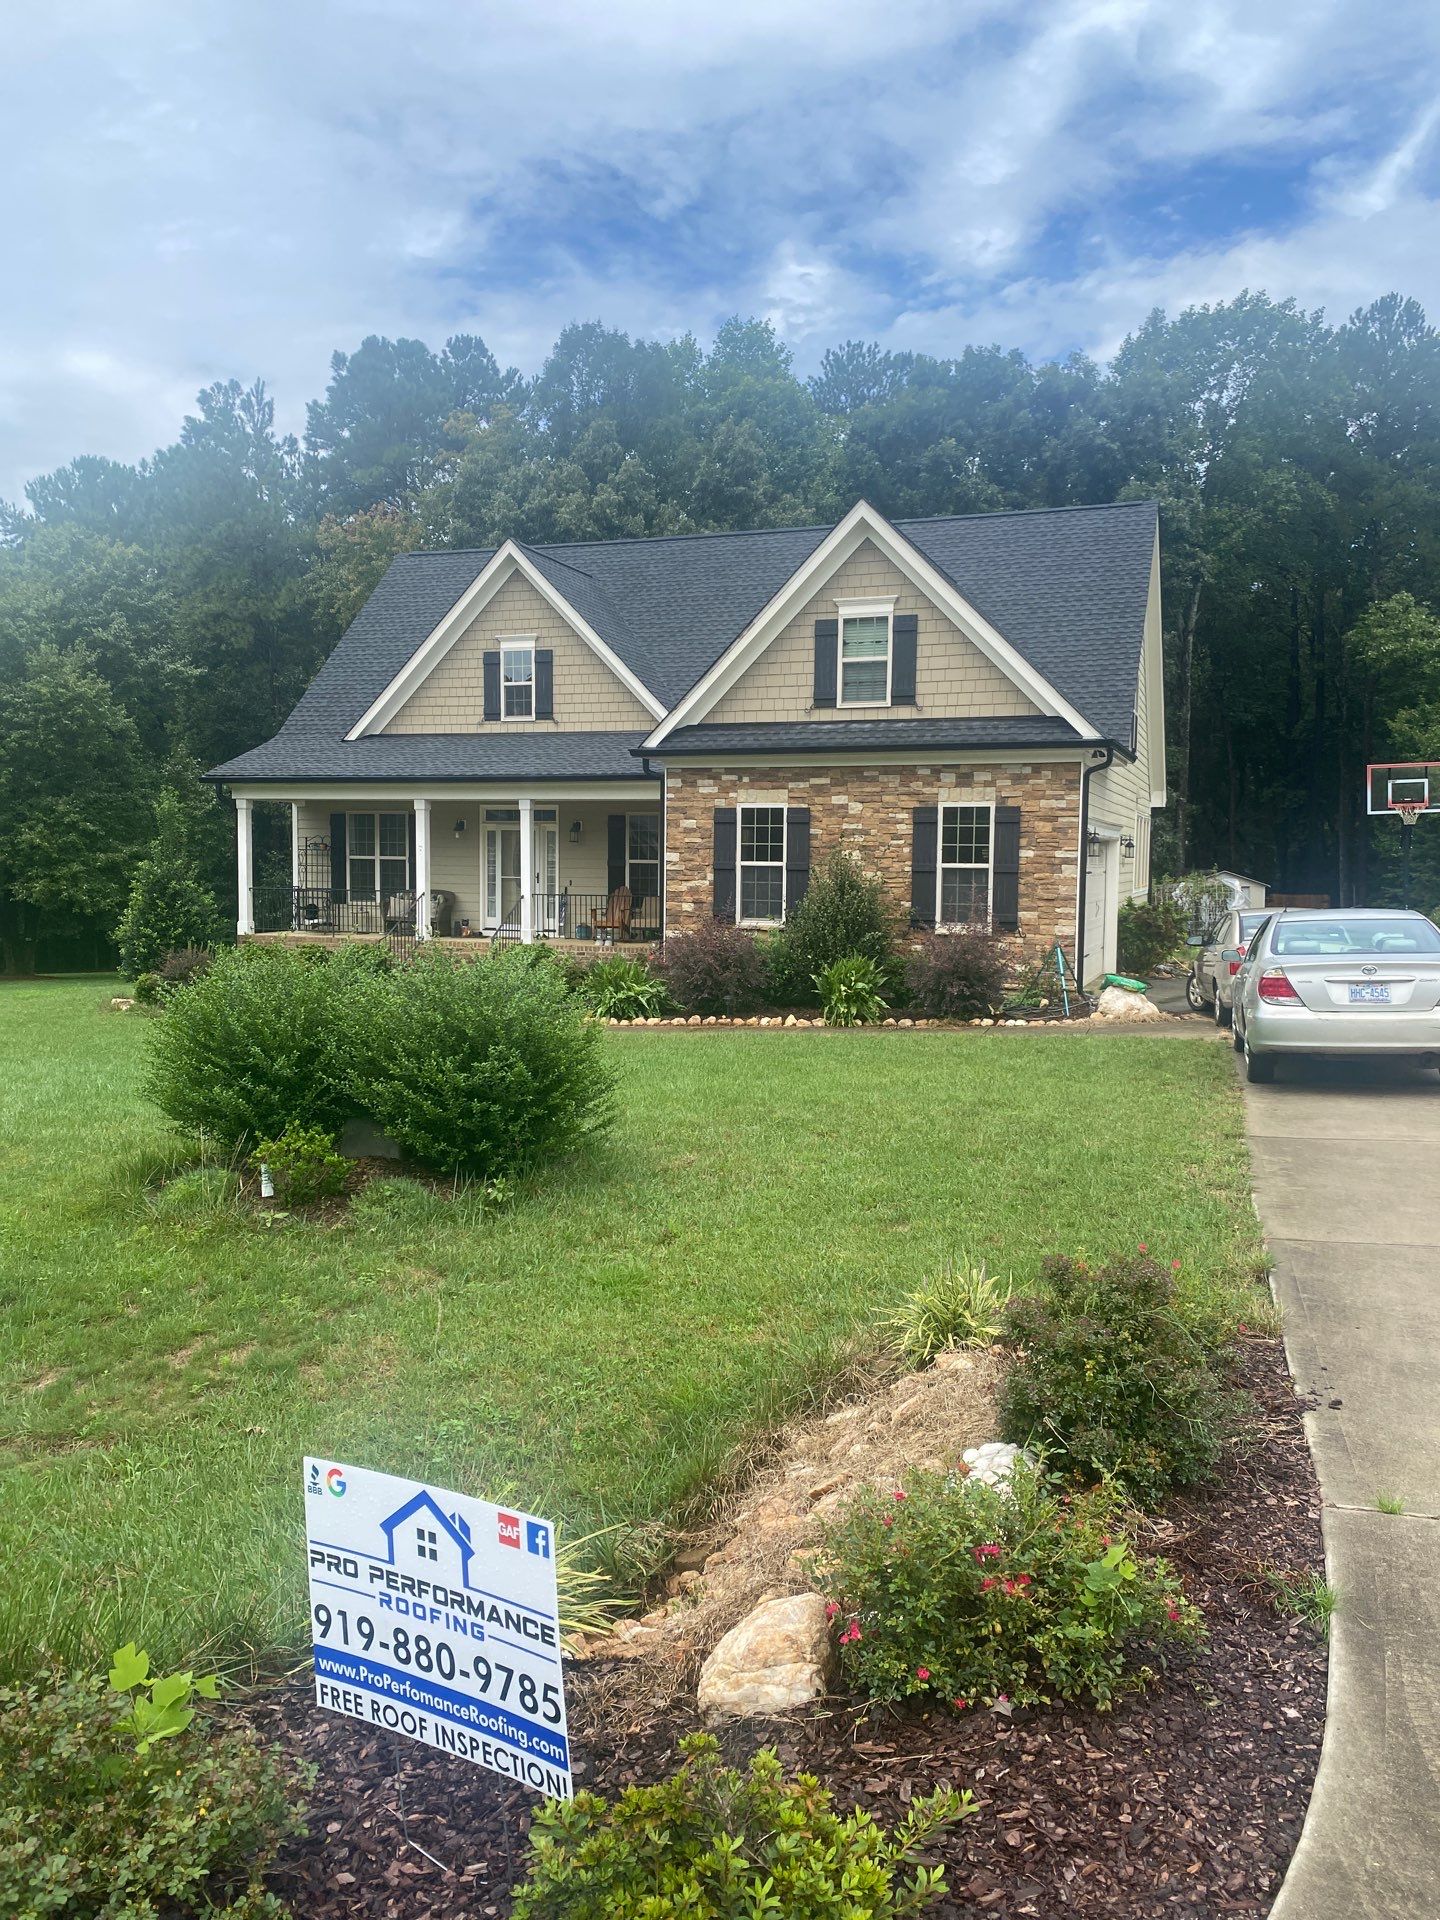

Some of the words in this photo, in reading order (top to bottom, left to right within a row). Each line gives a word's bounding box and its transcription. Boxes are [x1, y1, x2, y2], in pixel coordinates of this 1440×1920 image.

[307, 1484, 323, 1496] BBB
[326, 1468, 347, 1498] G
[497, 1520, 521, 1541] GAF
[310, 1549, 359, 1579] PRO
[369, 1565, 556, 1648] PERFORMANCE
[379, 1592, 485, 1642] ROOFING
[313, 1603, 562, 1725] 919-880-9785
[318, 1658, 565, 1762] www.ProPerfomanceRoofing.com
[320, 1684, 363, 1716] FREE
[371, 1698, 429, 1739] ROOF
[434, 1722, 568, 1799] INSPECTION!
